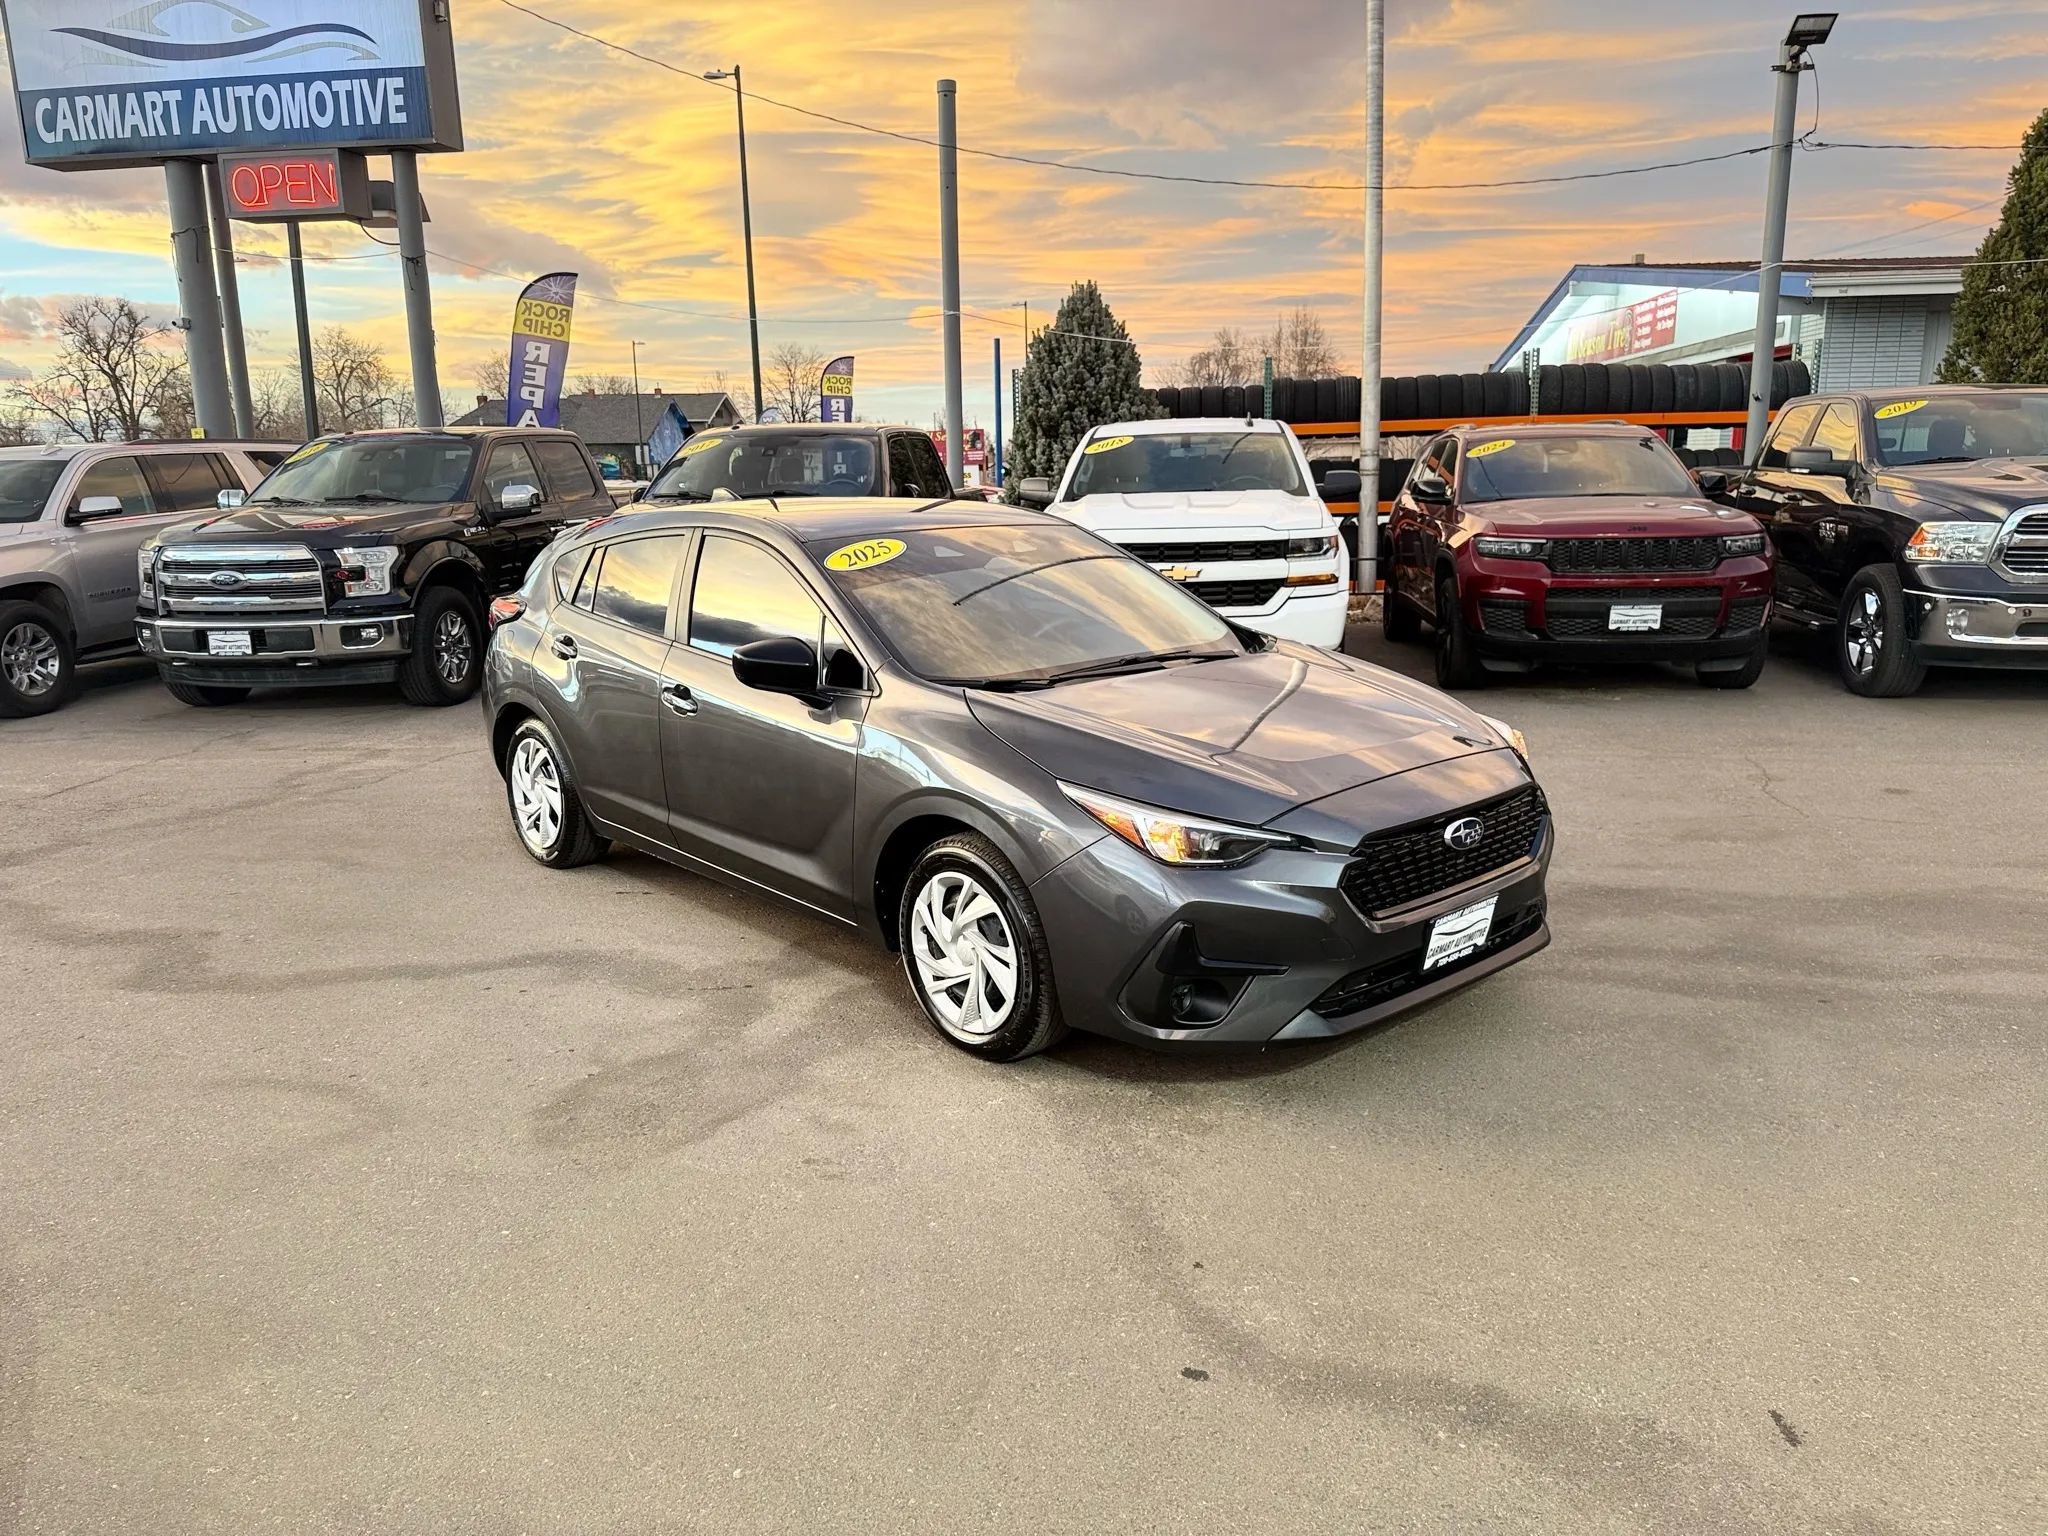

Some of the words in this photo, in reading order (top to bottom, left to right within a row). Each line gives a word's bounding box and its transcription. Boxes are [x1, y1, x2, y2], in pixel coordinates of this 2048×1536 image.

[34, 89, 182, 144] CARMART
[192, 77, 408, 135] AUTOMOTIVE
[231, 163, 337, 207] OPEN
[839, 541, 892, 568] 2025
[1435, 910, 1463, 926] CARMART
[1462, 895, 1499, 917] AUTOMOTIVE
[1426, 939, 1456, 960] CARMART
[1453, 926, 1488, 949] AUTOMOTIVE
